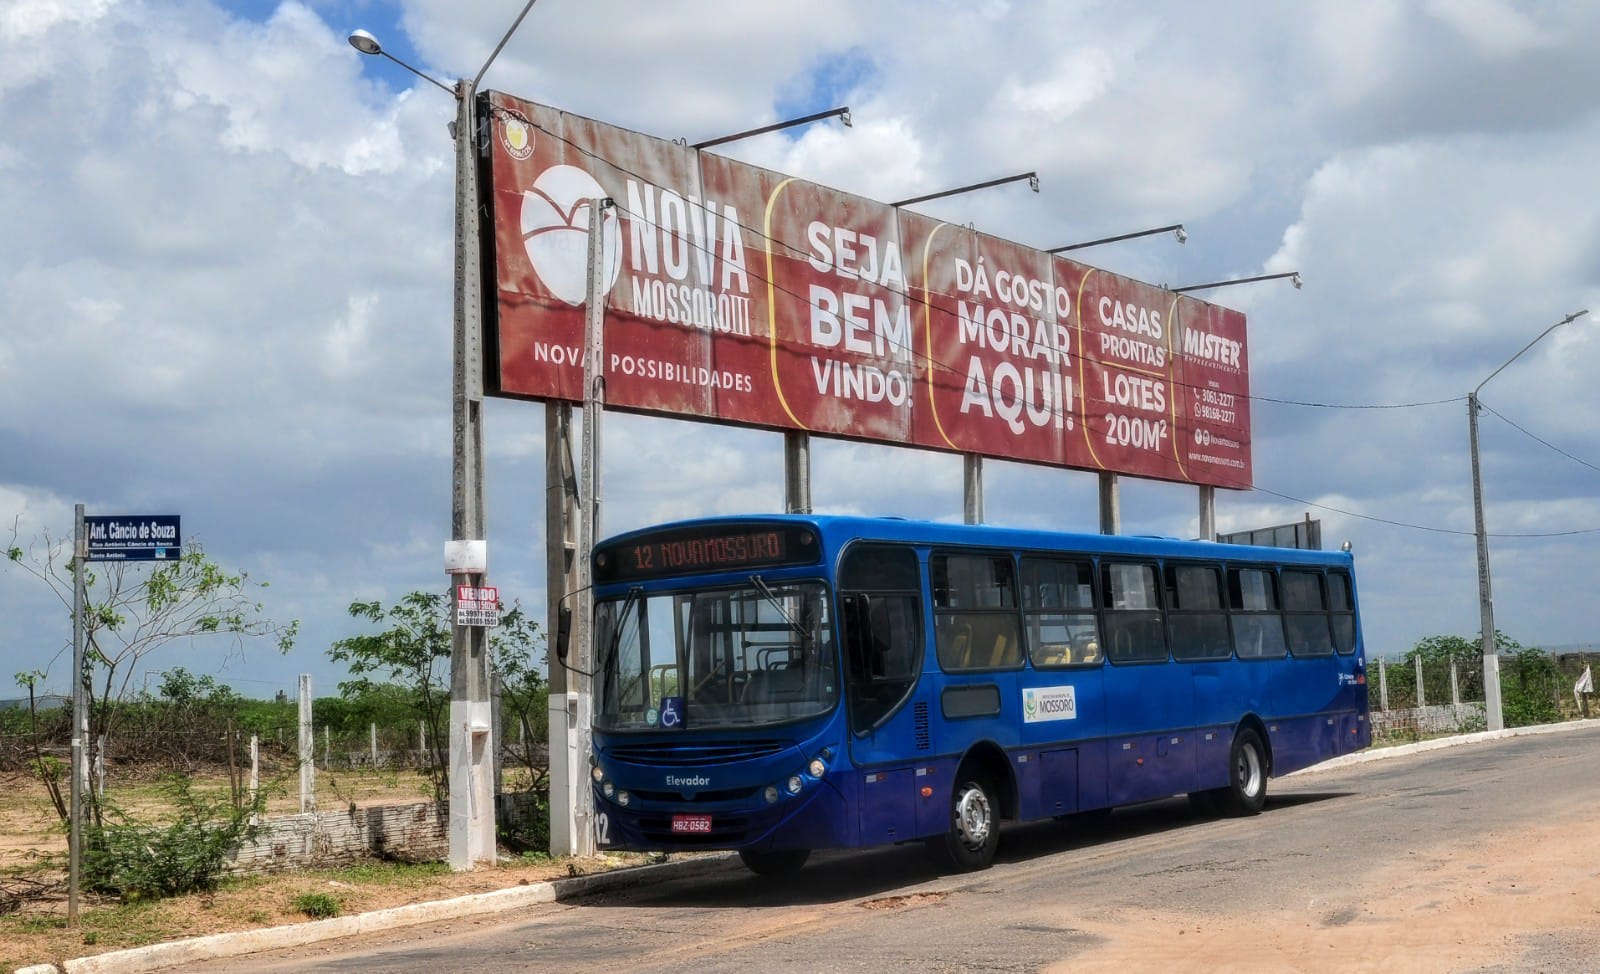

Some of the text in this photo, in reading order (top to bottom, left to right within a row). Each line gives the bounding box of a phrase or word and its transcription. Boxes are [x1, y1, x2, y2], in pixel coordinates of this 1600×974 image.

[627, 179, 749, 293] NOVA
[806, 220, 910, 291] SEJA
[955, 254, 1071, 318] DÁ GOSTO
[808, 284, 913, 361] BEM
[958, 300, 1072, 367] MORAR
[1098, 296, 1162, 339] CASAS
[1100, 332, 1165, 368] PRONTAS
[611, 354, 753, 393] POSSIBILIDADES
[811, 356, 914, 408] VINDO!
[1103, 371, 1166, 413] LOTES
[959, 355, 1073, 435] AQUI!
[90, 522, 107, 540] Ant.
[138, 521, 150, 539] de
[151, 521, 176, 539] Souza
[633, 545, 653, 569] 12
[460, 587, 496, 601] VENDO
[1040, 695, 1074, 713] MOSSORÓ
[666, 775, 710, 786] Elevador
[594, 812, 610, 844] 12
